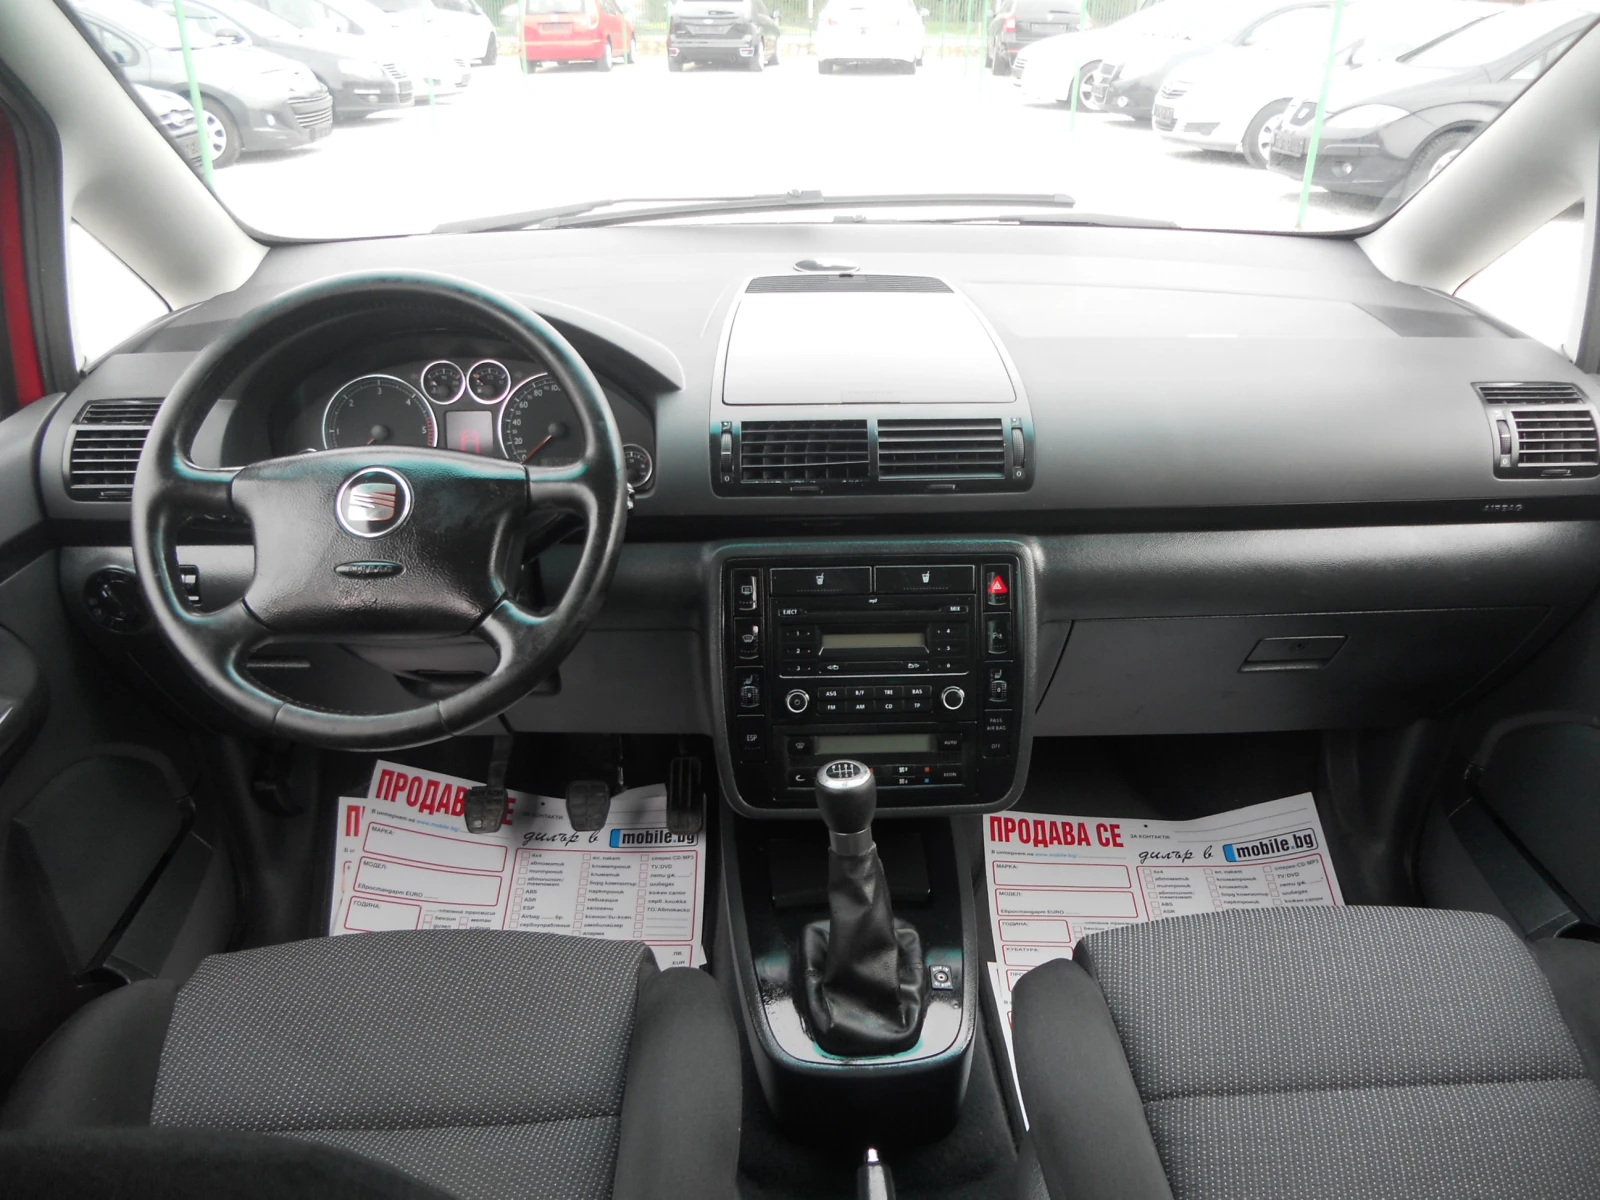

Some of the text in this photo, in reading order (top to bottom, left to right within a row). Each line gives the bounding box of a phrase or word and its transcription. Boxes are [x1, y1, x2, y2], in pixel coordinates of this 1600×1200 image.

[378, 387, 382, 395] 3
[349, 399, 354, 407] 2
[376, 769, 466, 817] ПРОДАВ
[371, 826, 395, 835] МАРКА:
[989, 815, 1124, 848] ПРОДАВА СЕ
[1236, 832, 1315, 859] mobile.bg
[1138, 848, 1194, 865] дилър
